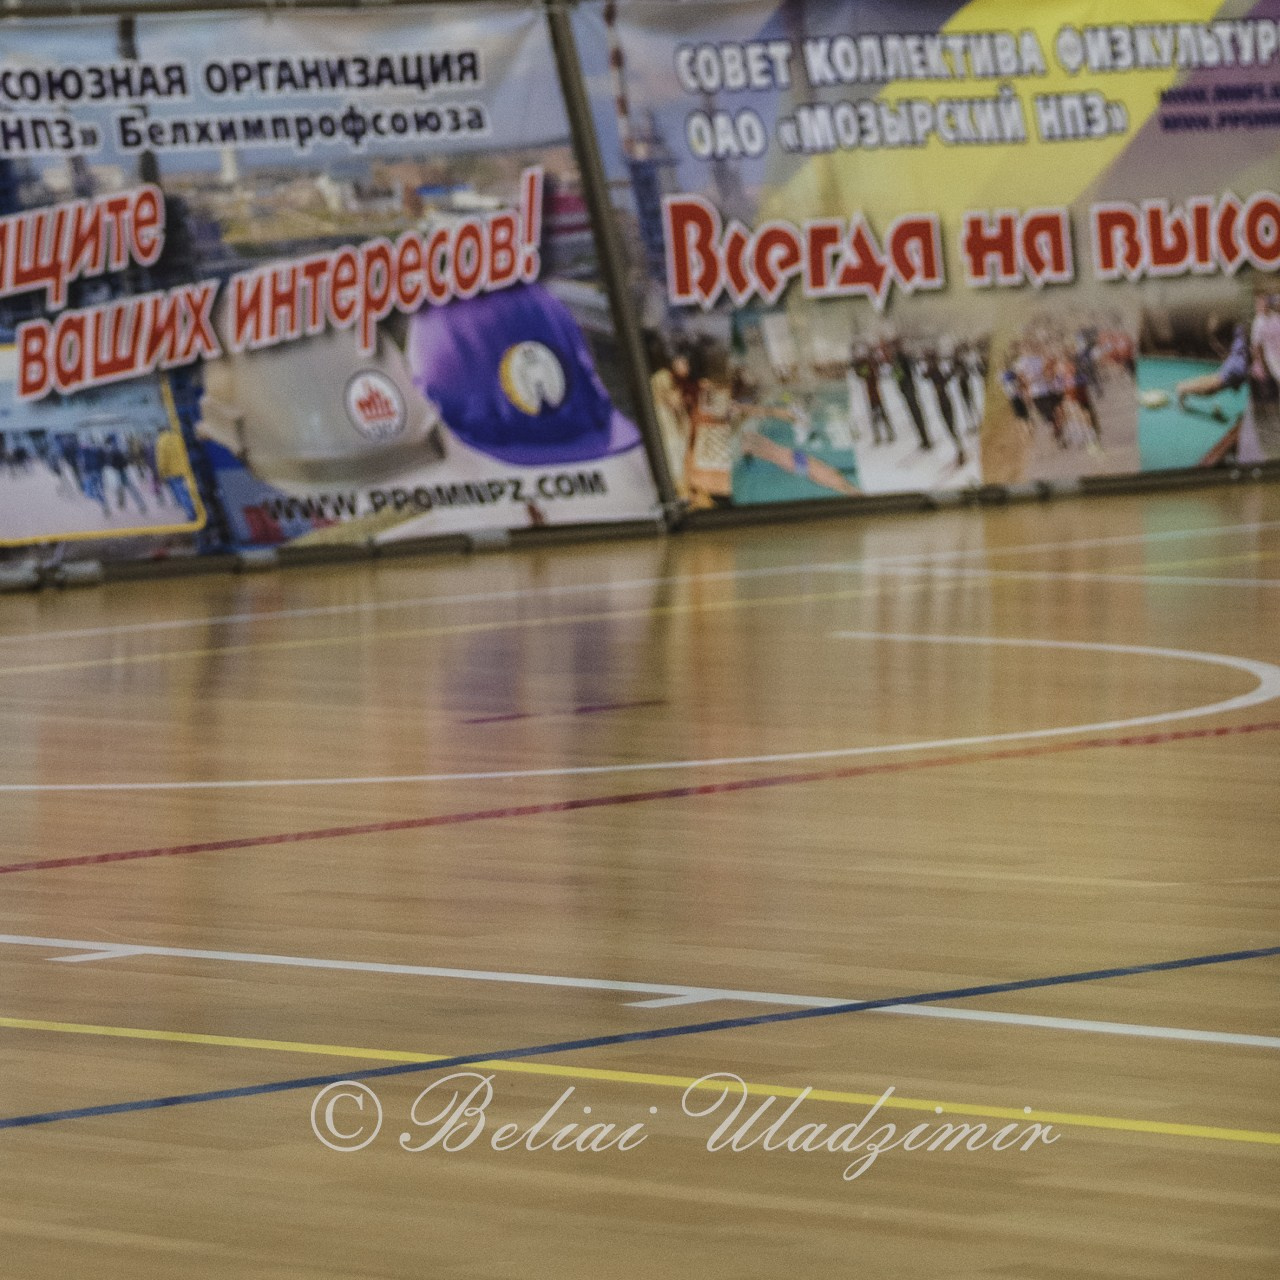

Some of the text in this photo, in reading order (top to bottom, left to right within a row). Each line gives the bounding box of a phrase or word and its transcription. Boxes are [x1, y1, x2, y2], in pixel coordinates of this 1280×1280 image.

[206, 52, 478, 93] ОРГАНИЗАЦИЯ
[676, 42, 793, 92] СОВЕТ
[803, 31, 1047, 86] КОЛЛЕКТИВА
[0, 118, 98, 152] НПЗ»
[120, 104, 484, 149] Белхимпрофсоюза
[687, 111, 765, 160] ОАО
[779, 84, 1027, 153] «МОЗЫРСКИЙ
[1035, 93, 1128, 142] НПЗ»
[668, 200, 939, 299] Всегда
[964, 212, 1068, 278] на
[20, 173, 536, 397] ваших интересов!
